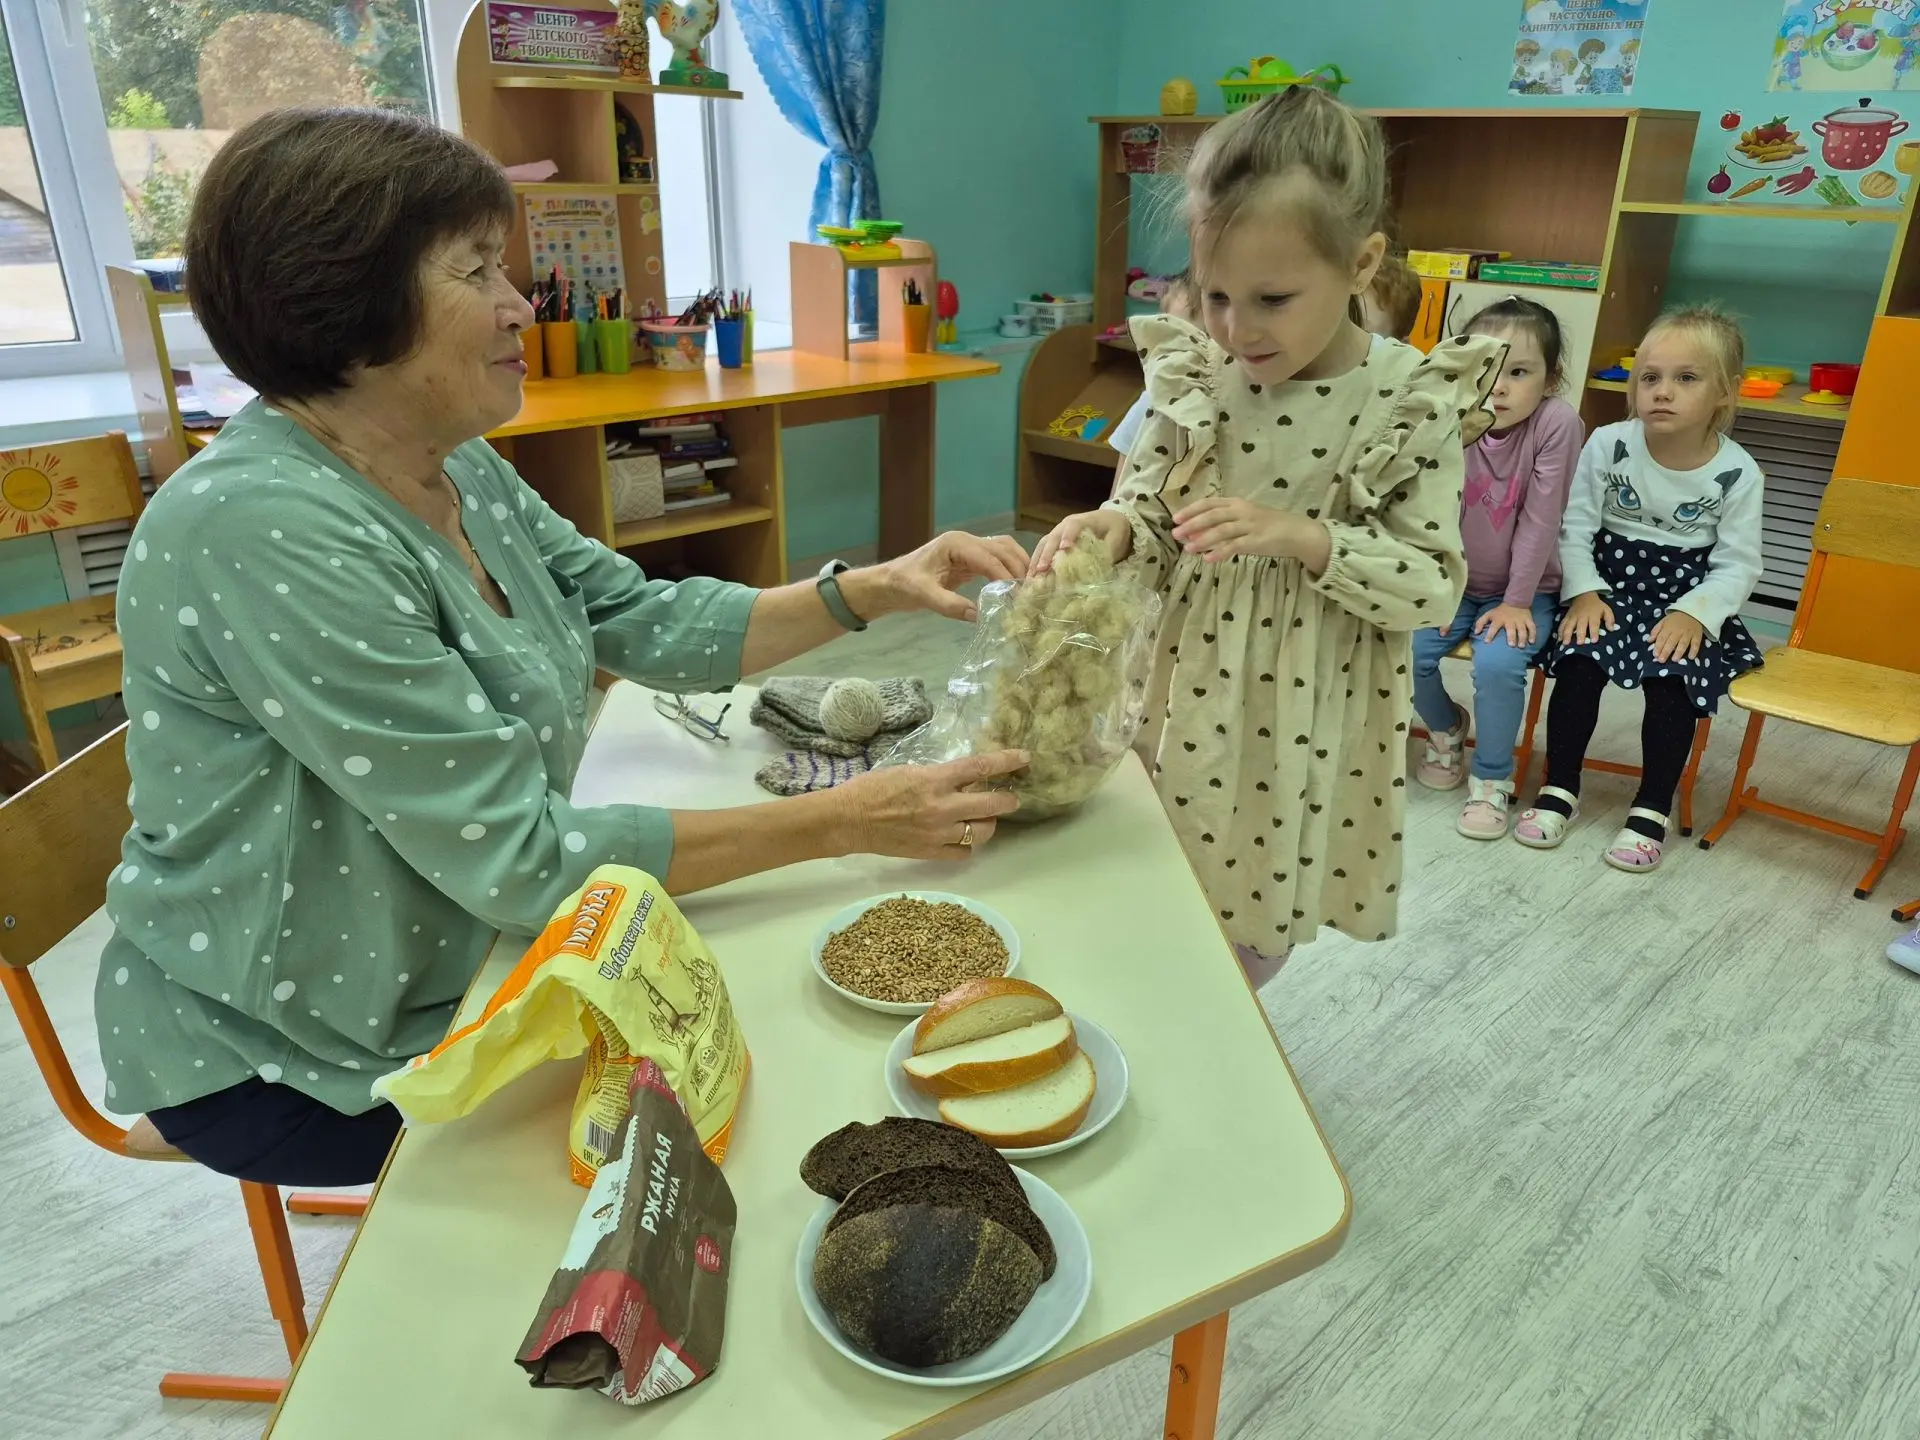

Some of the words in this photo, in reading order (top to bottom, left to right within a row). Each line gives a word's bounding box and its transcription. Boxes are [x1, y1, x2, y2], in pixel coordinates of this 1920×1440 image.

[536, 12, 577, 27] ЦЕНТР
[1549, 9, 1616, 20] НАСТОЛЬНО-
[527, 28, 588, 45] ДЕТСКОГО
[519, 44, 598, 61] ТВОРЧЕСТВА
[546, 199, 598, 211] ПАЛИТРА
[560, 887, 616, 950] МУКА
[598, 889, 655, 980] Чебоксарская
[640, 1131, 673, 1236] РЖАНАЯ
[664, 1176, 681, 1219] МУКА
